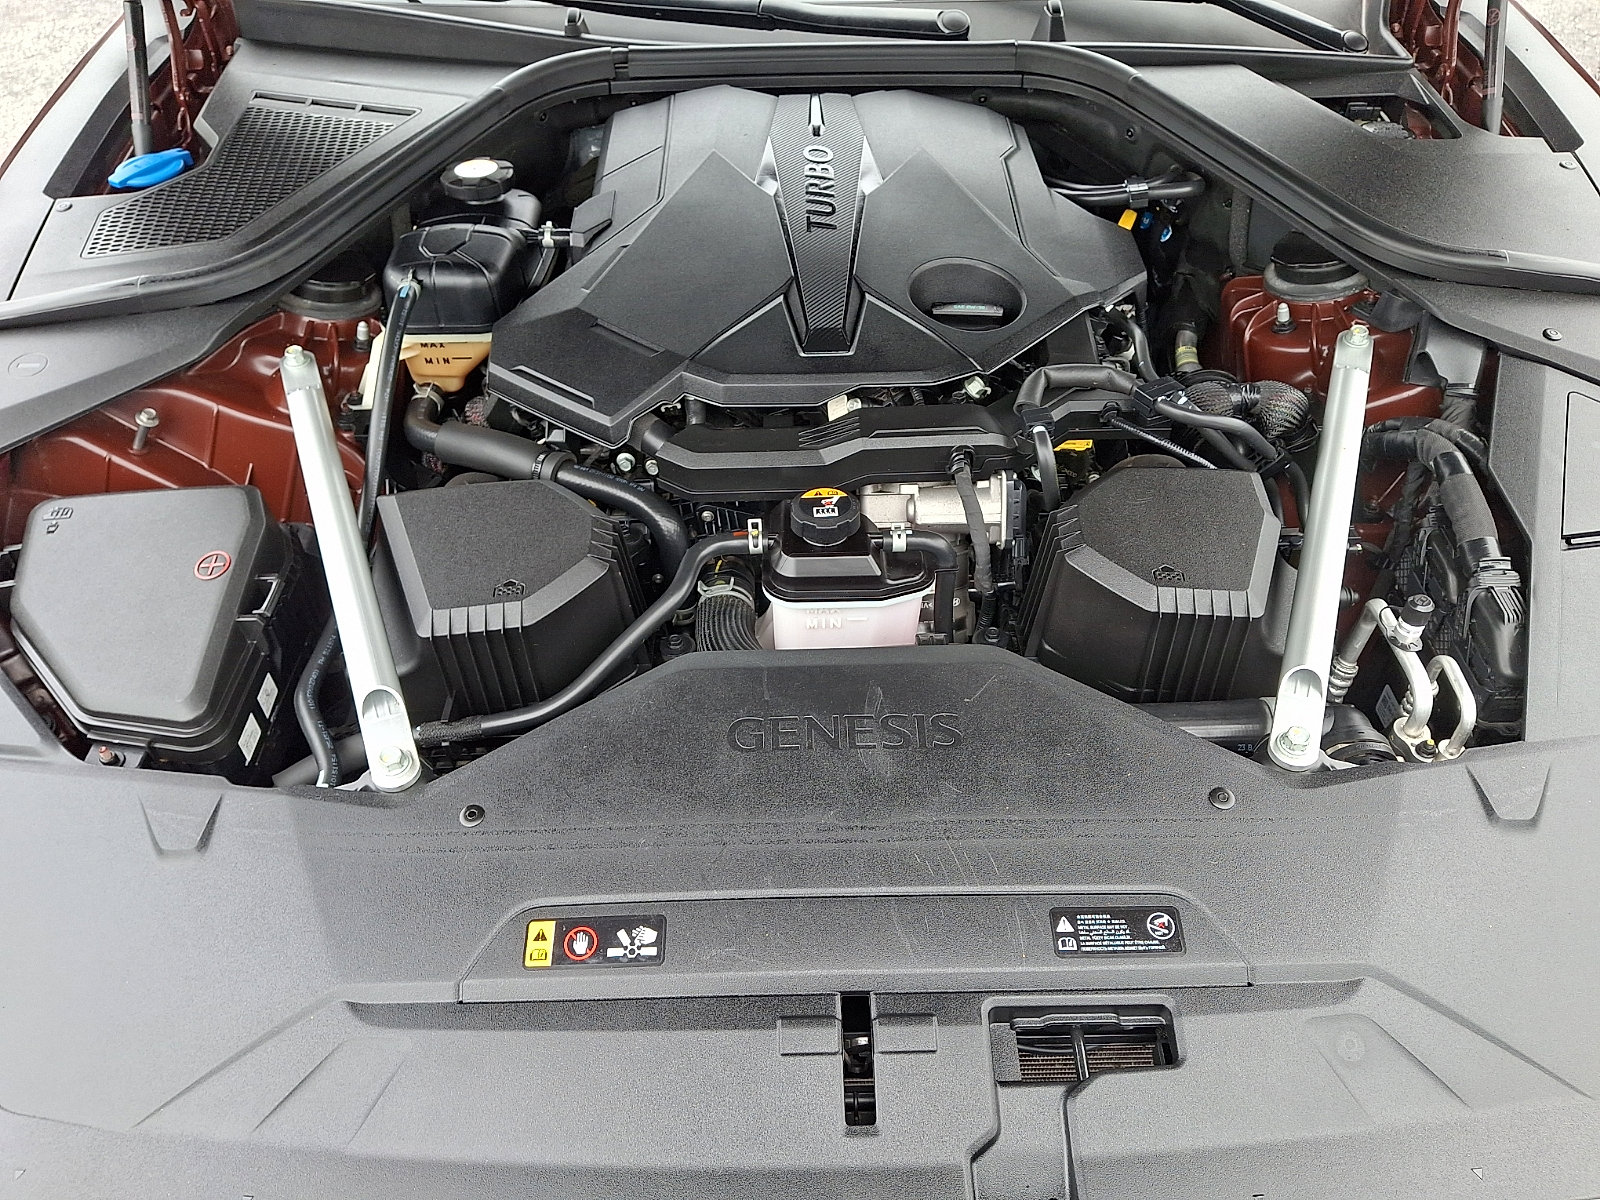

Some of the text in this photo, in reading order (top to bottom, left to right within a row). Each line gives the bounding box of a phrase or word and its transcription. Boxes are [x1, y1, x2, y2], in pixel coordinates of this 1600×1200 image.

[803, 145, 837, 232] TURBO
[424, 357, 451, 365] MIN
[805, 617, 842, 630] MIN
[727, 713, 963, 750] GENESIS
